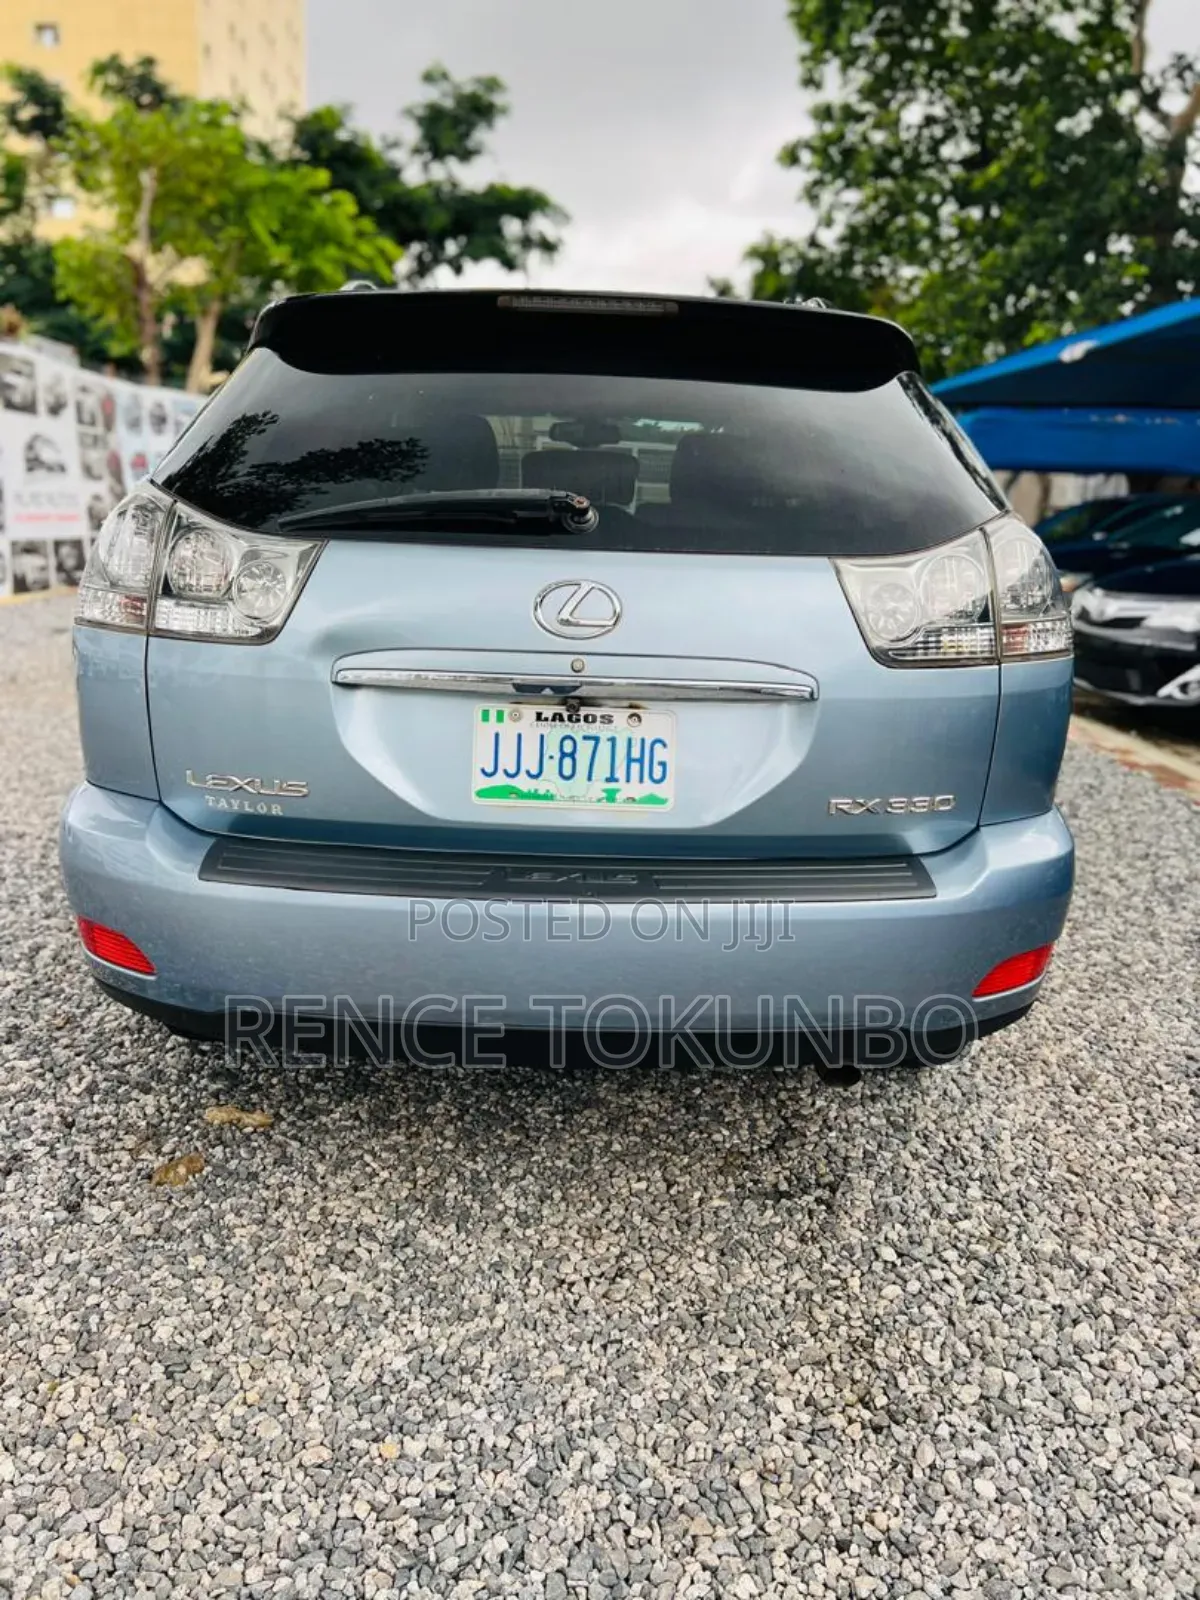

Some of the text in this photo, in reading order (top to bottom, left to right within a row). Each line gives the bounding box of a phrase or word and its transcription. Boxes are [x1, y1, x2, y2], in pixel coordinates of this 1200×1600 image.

[535, 711, 614, 724] LAGOS
[185, 769, 309, 797] LEXUS
[205, 795, 284, 816] TAYLOR
[828, 794, 956, 815] RX 330
